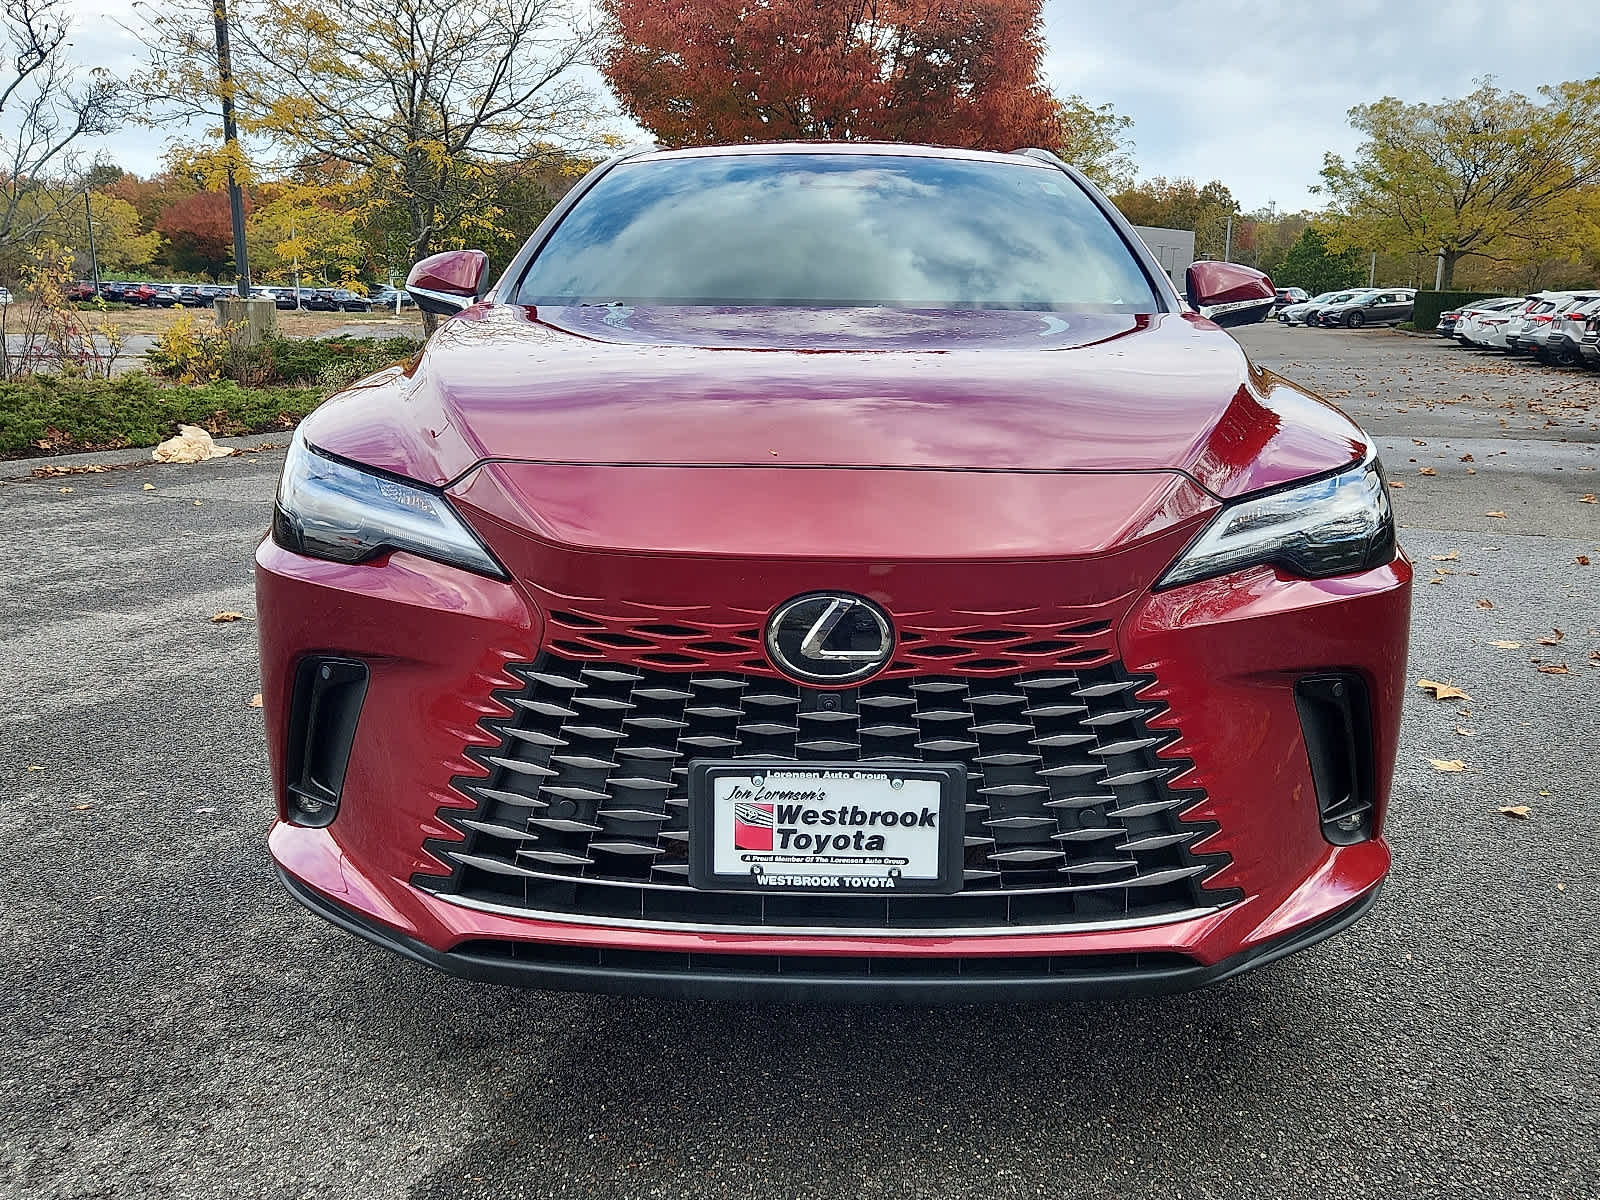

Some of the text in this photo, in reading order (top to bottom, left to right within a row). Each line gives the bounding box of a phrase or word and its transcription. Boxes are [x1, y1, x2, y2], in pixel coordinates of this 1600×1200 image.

[767, 770, 888, 780] Lorensen Auto Group
[724, 786, 826, 802] Jon Lorensen's
[776, 805, 937, 828] Westbrook
[777, 828, 885, 855] Toyota
[752, 855, 774, 863] Proud
[774, 856, 804, 864] Member
[830, 857, 863, 865] Lorensen
[756, 875, 896, 888] WESTBROOK TOYOTA
